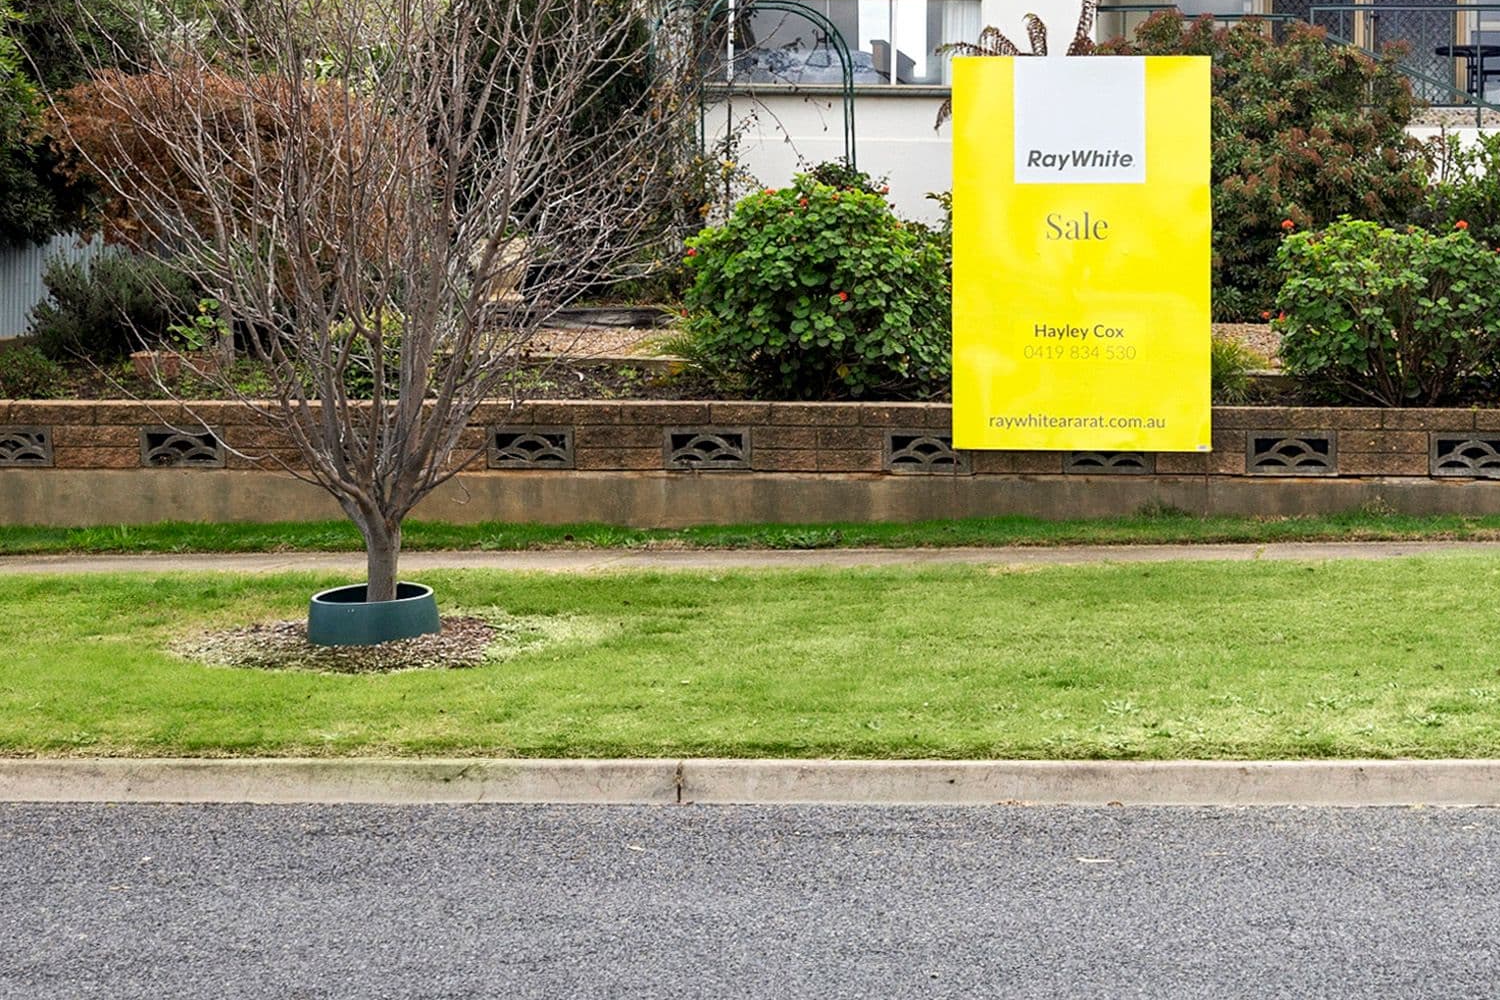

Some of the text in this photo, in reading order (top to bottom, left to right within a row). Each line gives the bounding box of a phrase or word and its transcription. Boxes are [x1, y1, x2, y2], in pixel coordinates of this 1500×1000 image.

[1046, 211, 1109, 241] Sale
[1034, 323, 1125, 341] Hayley Cox
[1023, 344, 1137, 361] 0419 834 530
[989, 413, 1167, 430] raywhiteararat.com.au
